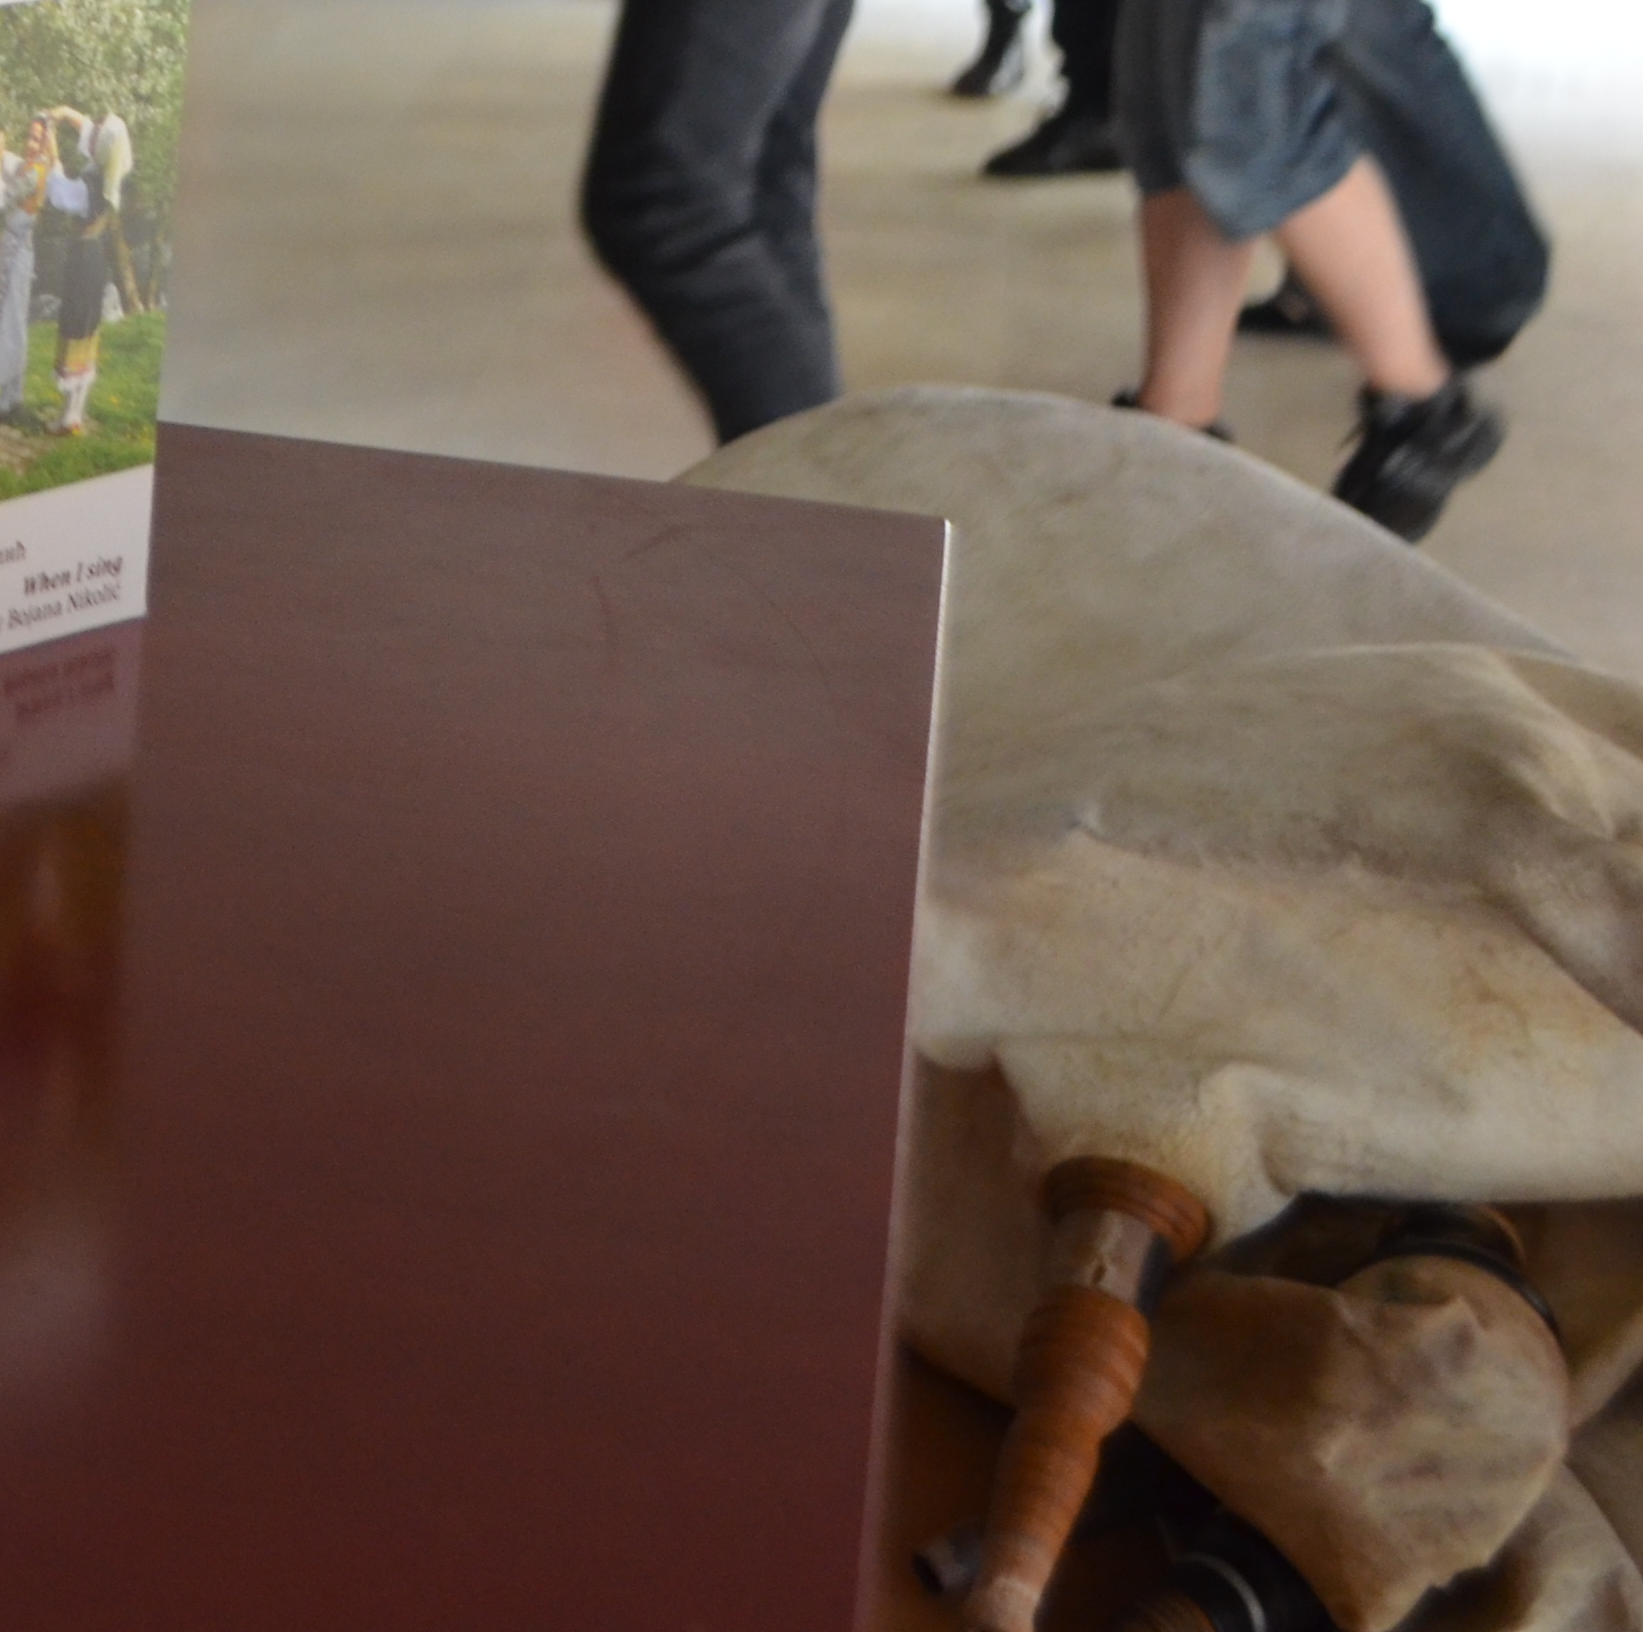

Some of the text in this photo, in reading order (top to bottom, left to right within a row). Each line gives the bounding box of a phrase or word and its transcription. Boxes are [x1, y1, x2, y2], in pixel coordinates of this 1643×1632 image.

[23, 570, 72, 596] When
[86, 556, 124, 580] sing
[6, 600, 63, 631] Bojana
